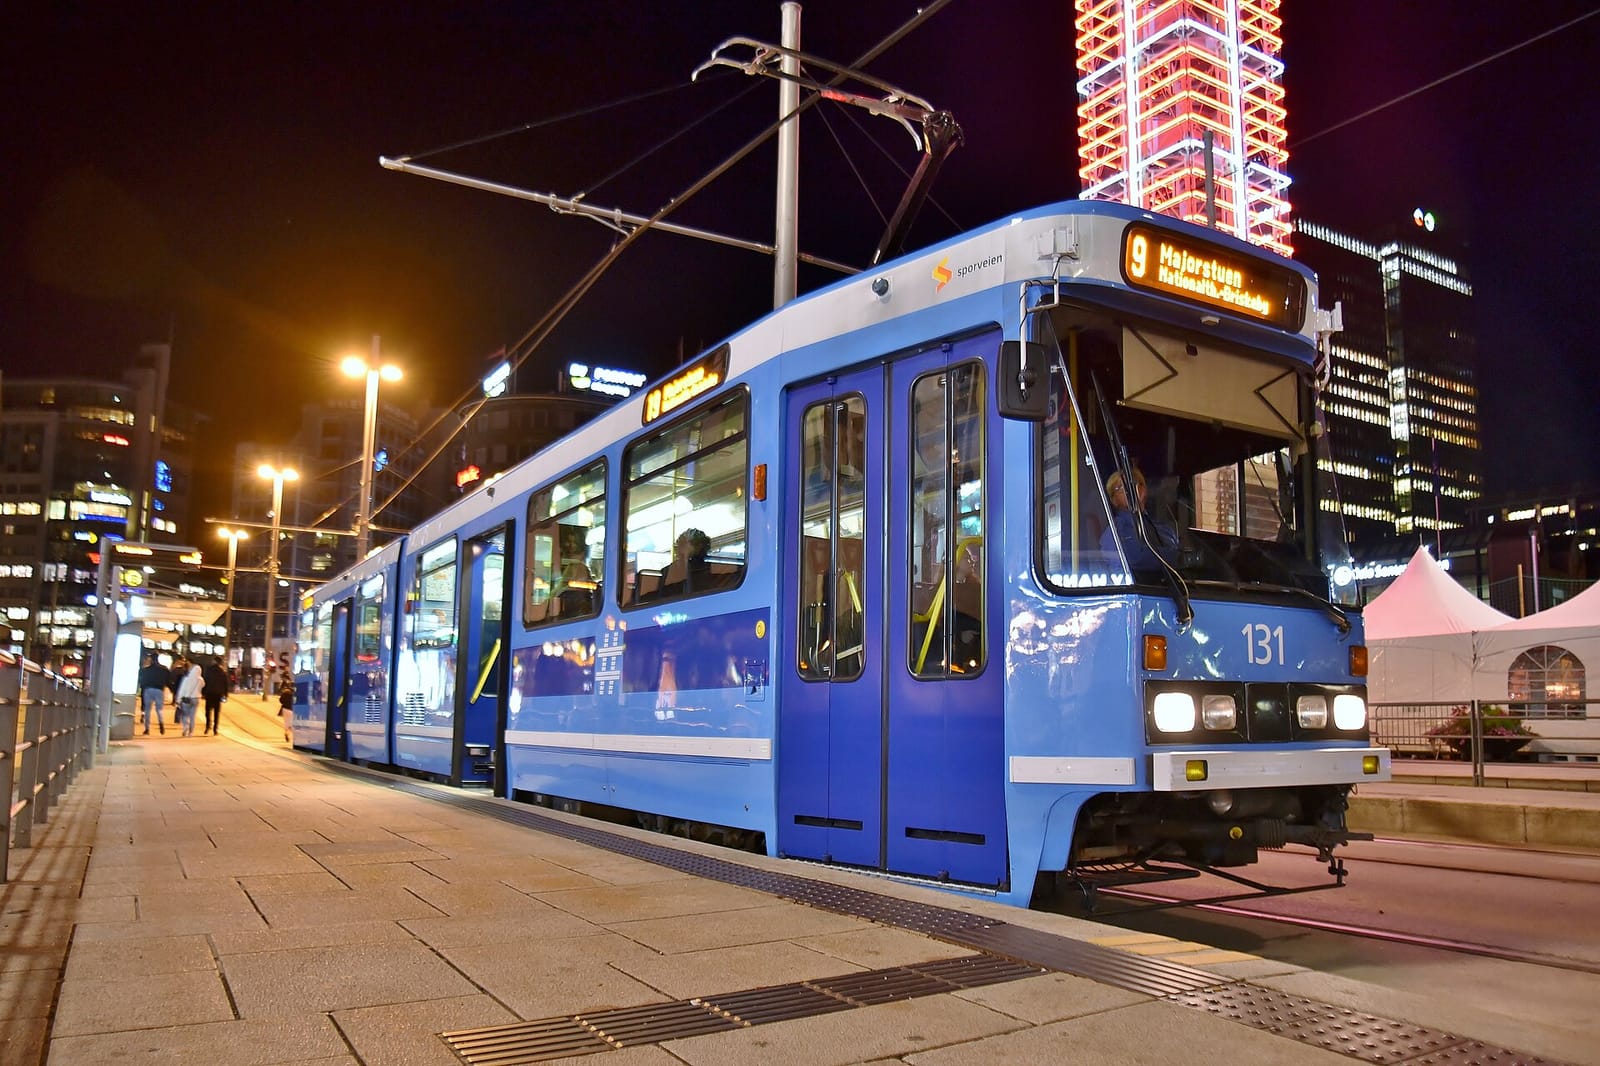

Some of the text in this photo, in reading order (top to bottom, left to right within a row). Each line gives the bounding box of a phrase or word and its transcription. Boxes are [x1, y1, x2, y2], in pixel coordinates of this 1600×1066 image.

[957, 254, 1003, 277] sporveien
[1130, 234, 1148, 279] 9
[1159, 242, 1243, 289] Majorstuen
[1241, 623, 1286, 666] 131
